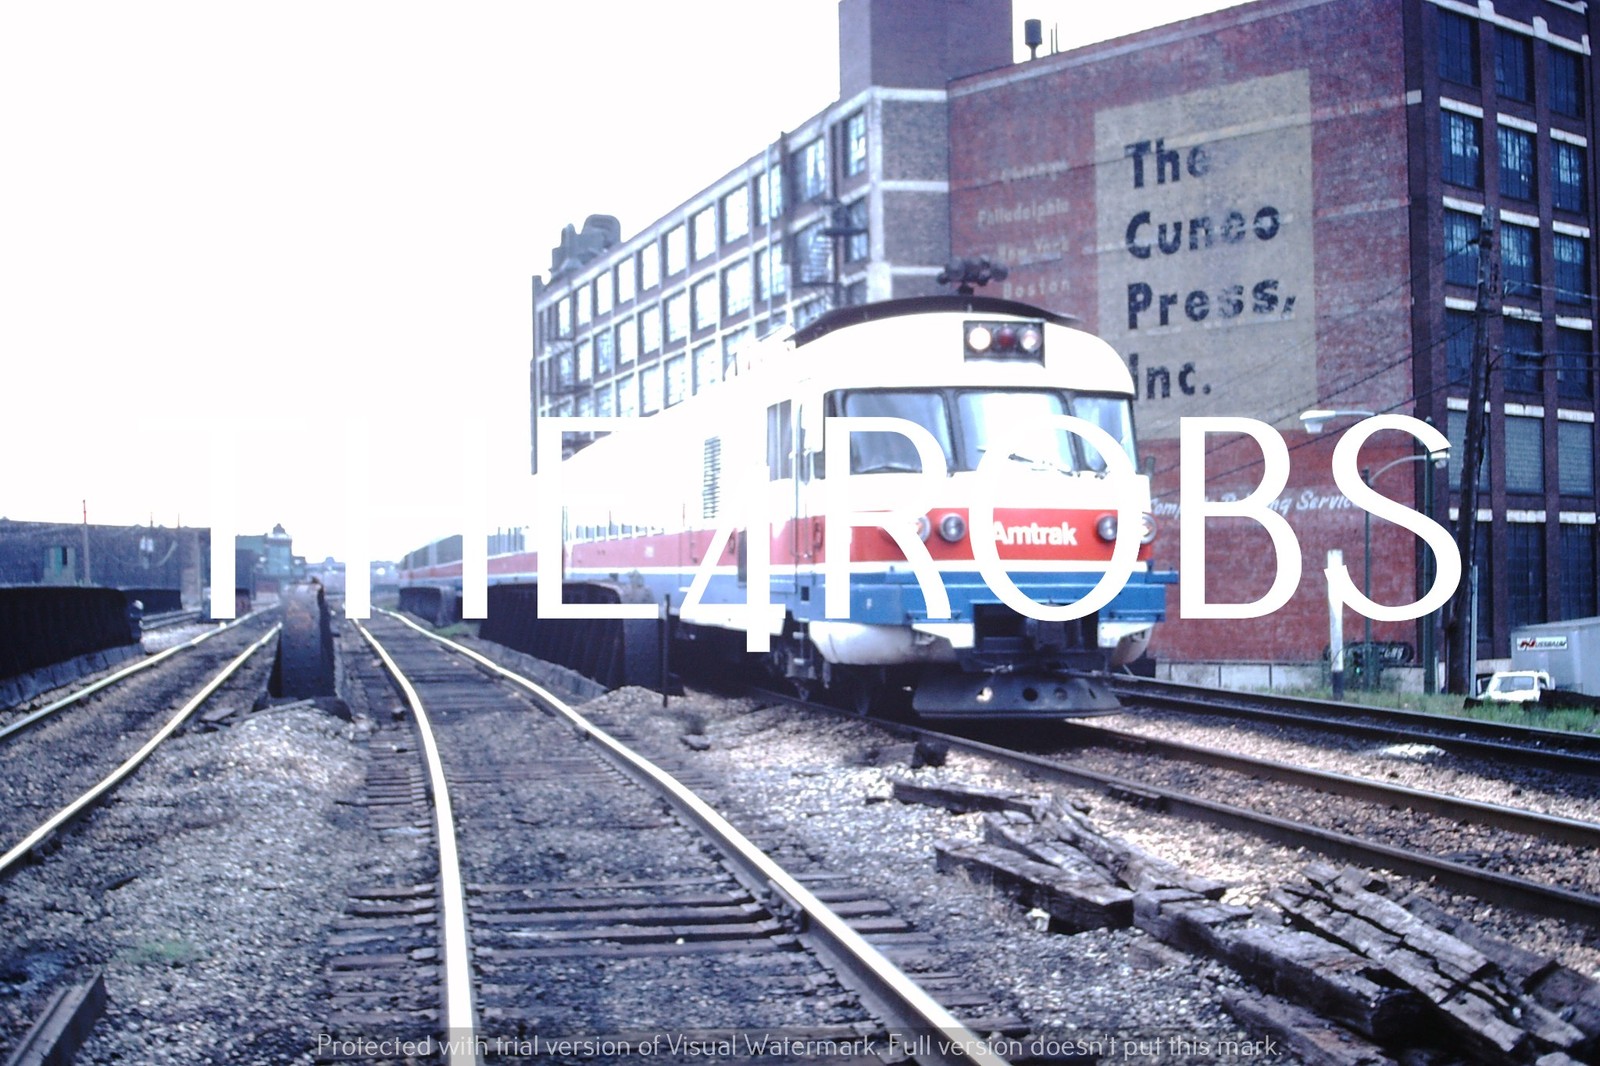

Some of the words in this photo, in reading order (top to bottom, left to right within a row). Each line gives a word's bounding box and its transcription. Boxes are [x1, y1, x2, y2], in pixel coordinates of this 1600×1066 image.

[1124, 138, 1210, 188] The
[1126, 206, 1280, 259] Cuneo
[1003, 278, 1070, 300] Boston
[1127, 279, 1296, 330] Press,
[1128, 353, 1212, 400] Inc.
[1296, 489, 1361, 511] Servic
[993, 520, 1078, 546] Amtrak
